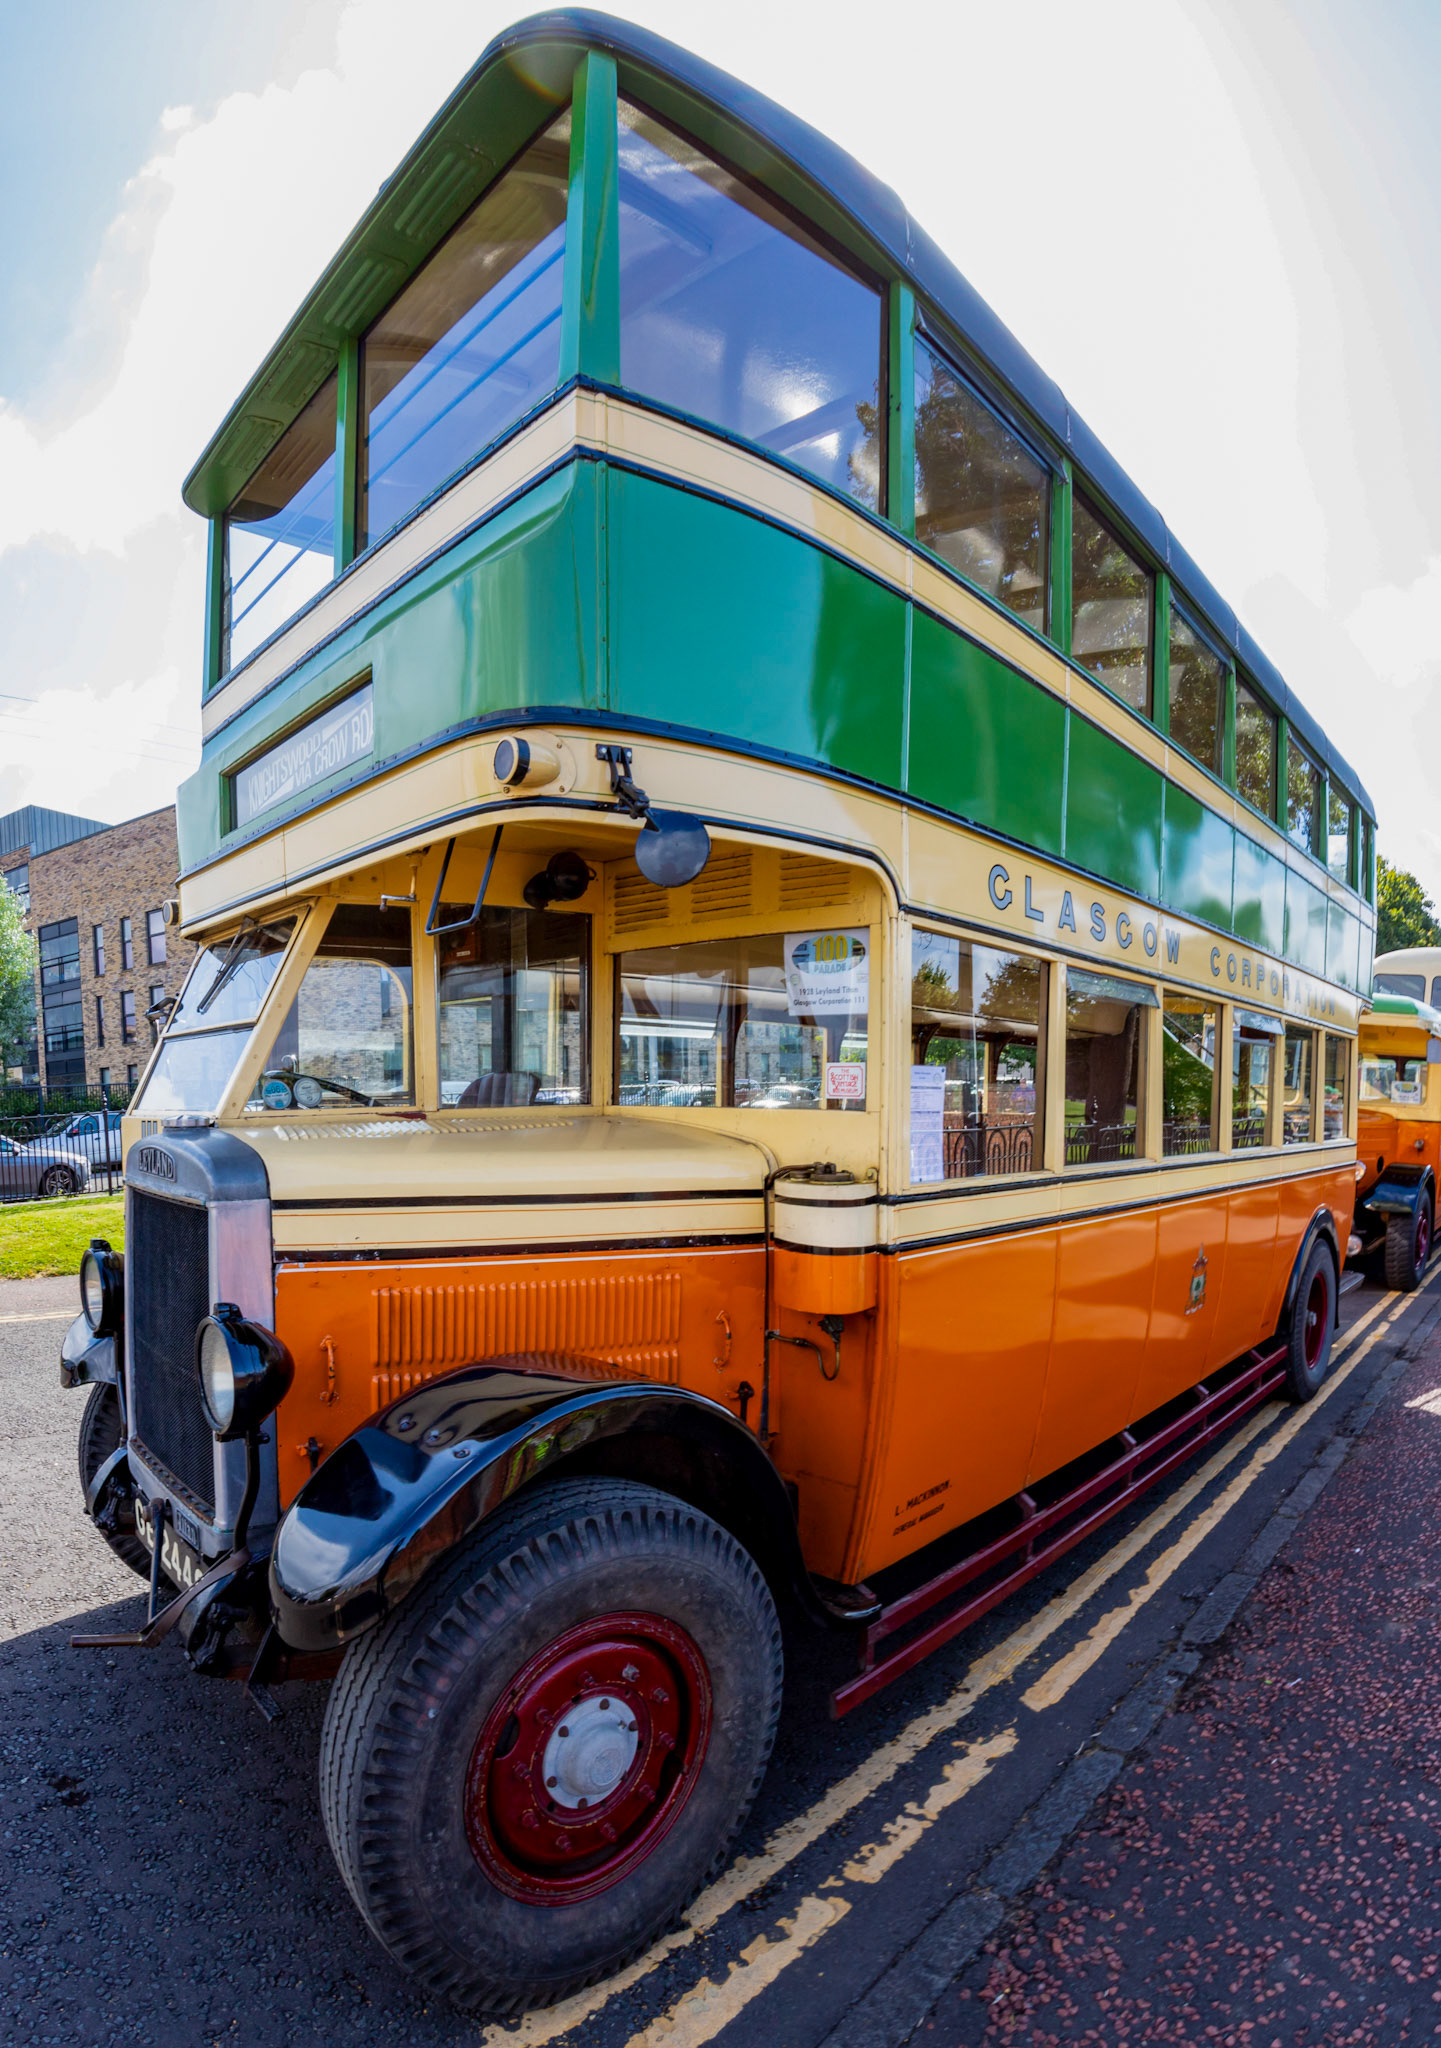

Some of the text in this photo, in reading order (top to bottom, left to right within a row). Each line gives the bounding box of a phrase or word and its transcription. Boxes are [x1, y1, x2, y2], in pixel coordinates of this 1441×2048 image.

[295, 761, 312, 787] VIA
[315, 724, 348, 775] CROW
[248, 732, 321, 815] KNIGHTSWOOD
[812, 934, 848, 963] 100
[988, 864, 1335, 1016] GLASGOW CORPORATION
[814, 963, 846, 973] PARADE
[793, 998, 817, 1008] Glasgow
[818, 996, 851, 1006] Corporation
[799, 987, 814, 996] 1928
[815, 986, 841, 996] Leyland
[139, 1148, 174, 1178] LEYLAND
